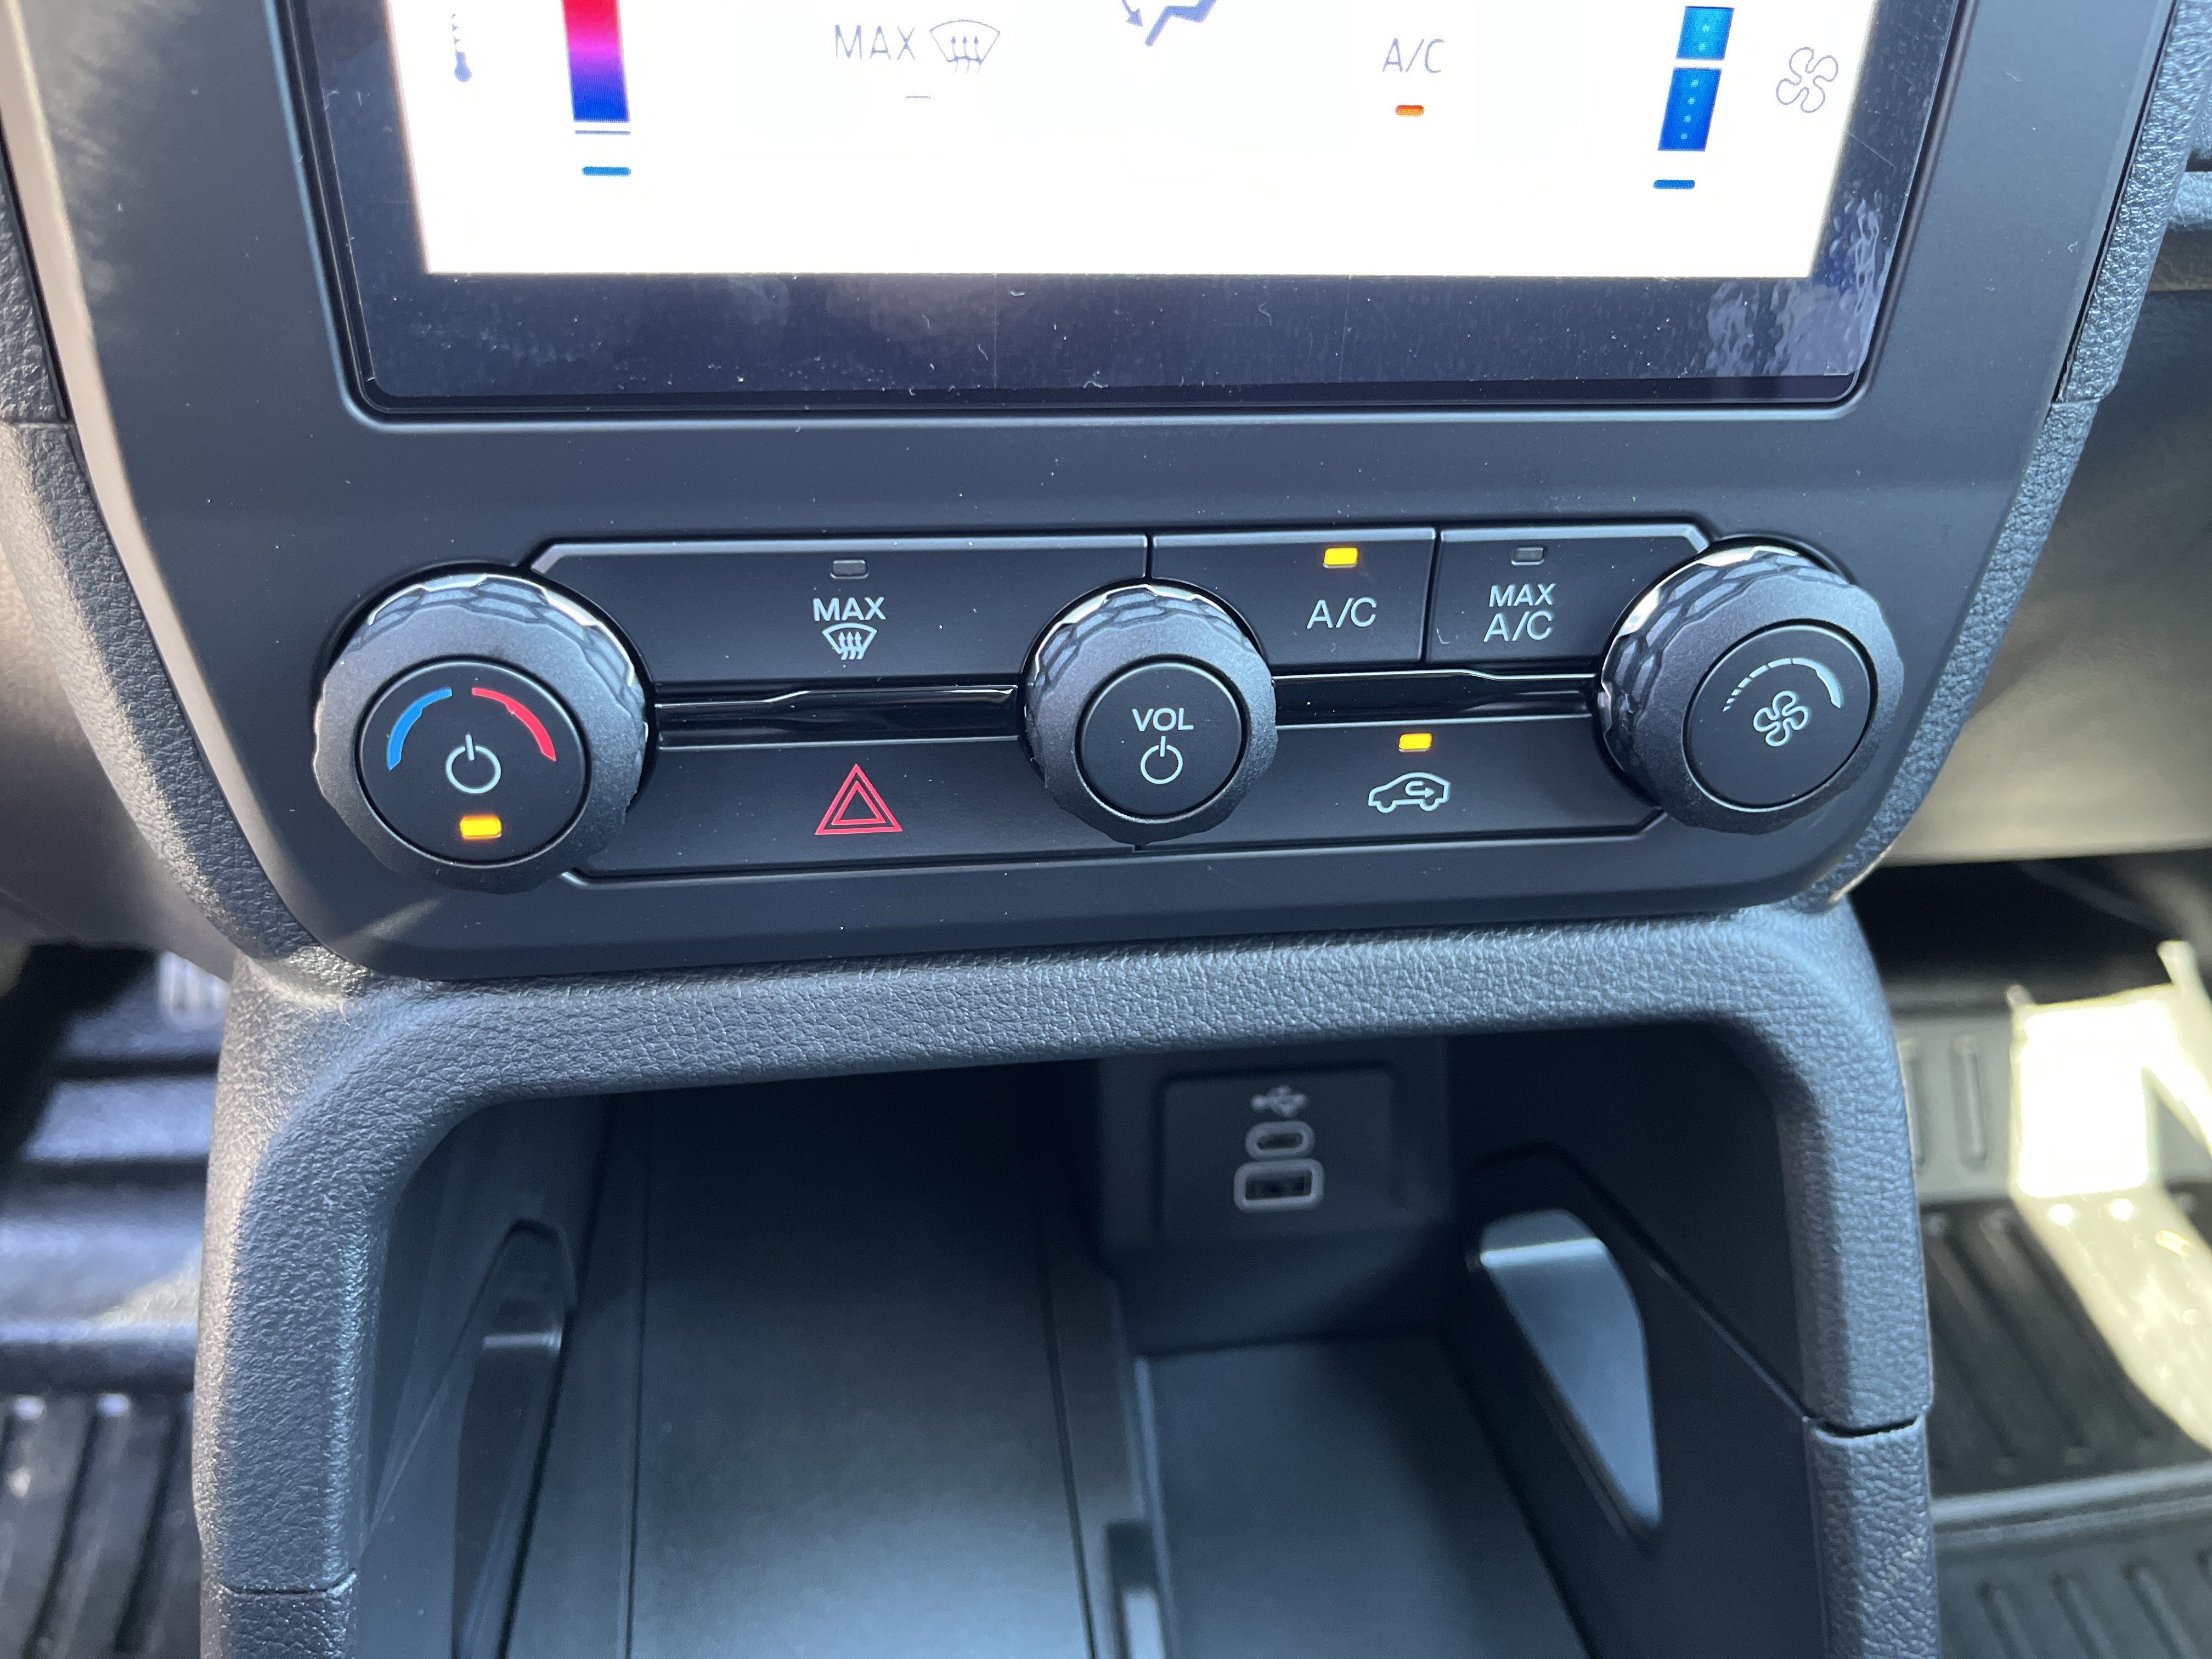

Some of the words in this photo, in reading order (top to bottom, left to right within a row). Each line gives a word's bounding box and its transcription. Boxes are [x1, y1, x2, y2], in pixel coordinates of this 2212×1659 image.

[835, 25, 915, 60] MAX
[1382, 38, 1444, 73] A/C
[812, 597, 886, 620] MAX
[1489, 583, 1556, 607] MAX
[1307, 597, 1377, 629] A/C
[1483, 610, 1555, 642] A/C
[1132, 707, 1194, 731] VOL
